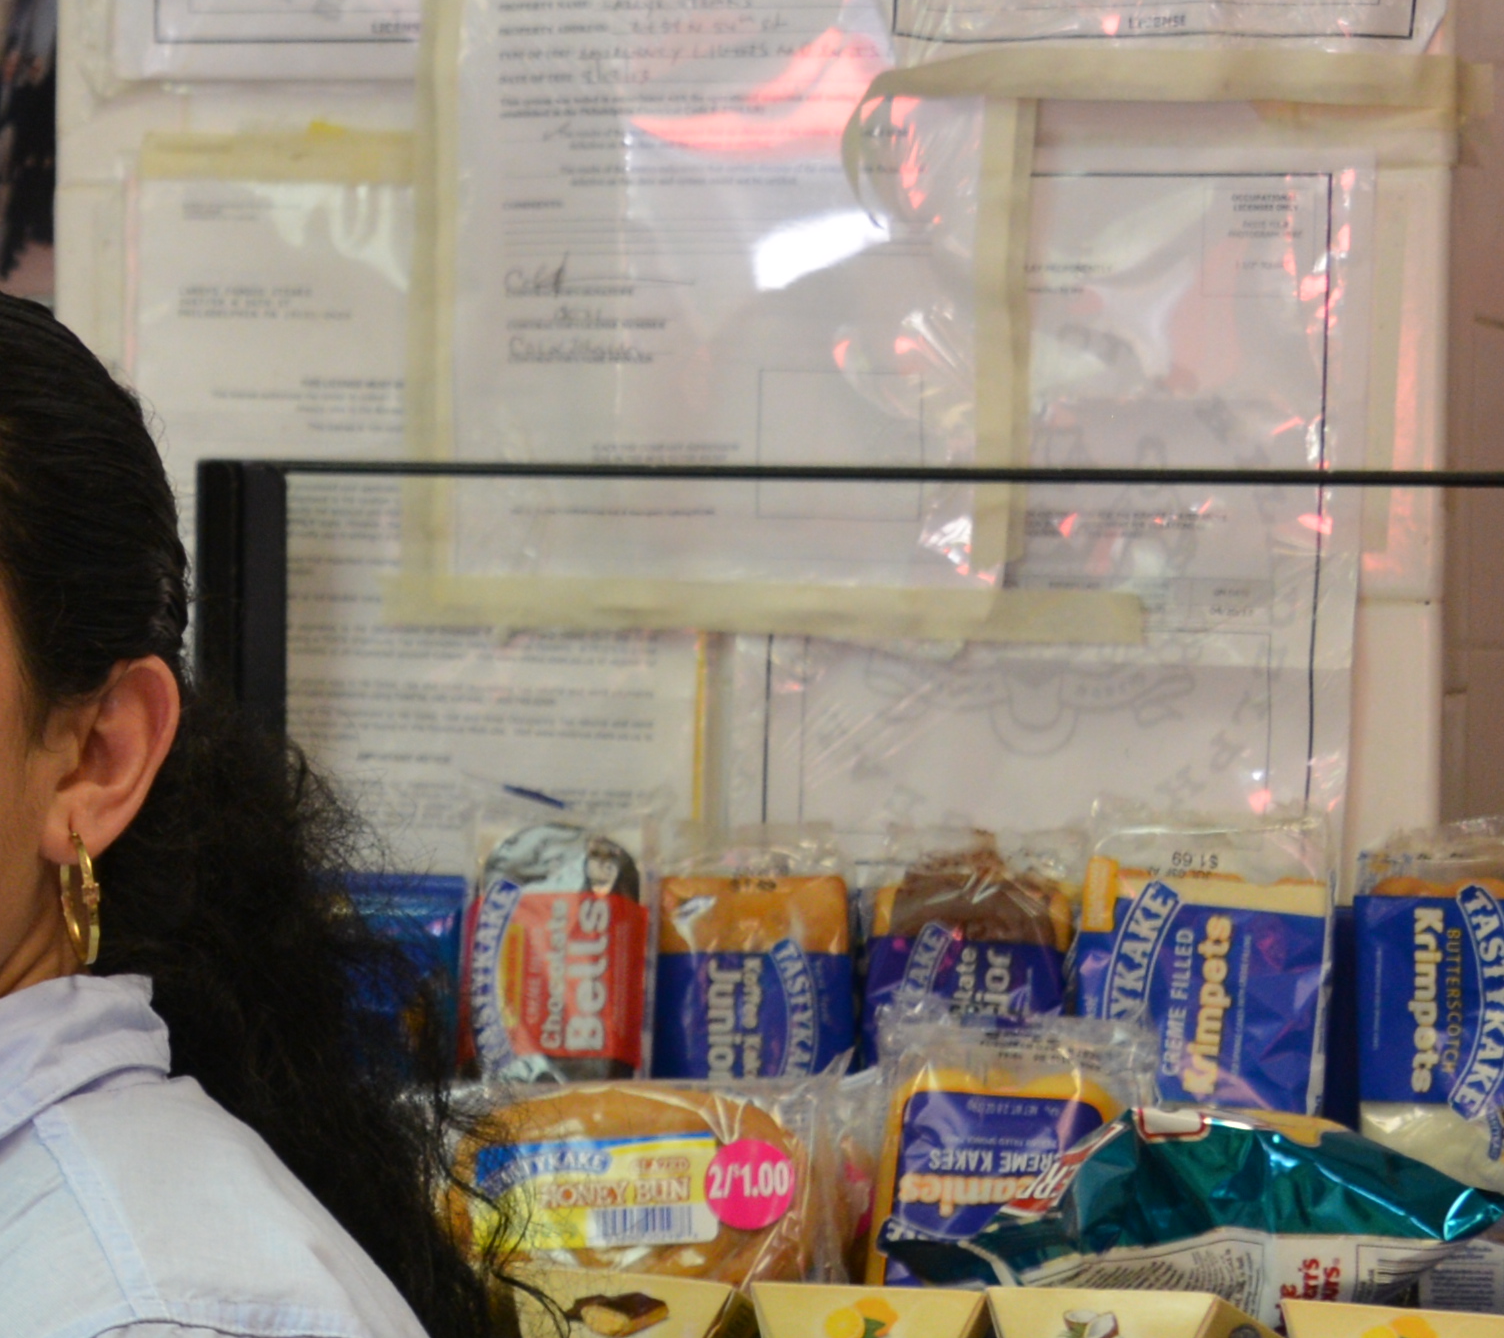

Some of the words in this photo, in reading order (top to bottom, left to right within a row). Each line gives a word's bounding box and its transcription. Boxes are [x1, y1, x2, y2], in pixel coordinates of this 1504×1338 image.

[540, 898, 569, 1050] Chocolate
[565, 898, 611, 1052] Bells
[742, 957, 764, 1029] Koffee
[772, 942, 817, 1079] TASTYKA
[1109, 881, 1180, 1021] YKAKE
[1171, 927, 1195, 998] FILLED
[1183, 913, 1234, 1095] Krimpets
[1408, 907, 1445, 1094] Krimpets
[1442, 927, 1463, 1074] BUTTERSCOTCH
[1456, 888, 1504, 1114] TASTYKAKE
[1161, 1001, 1188, 1076] CREME
[540, 1179, 629, 1210] HONEY
[634, 1177, 692, 1202] BUN
[899, 1173, 1024, 1218] eamies
[928, 1148, 995, 1172] KAKES
